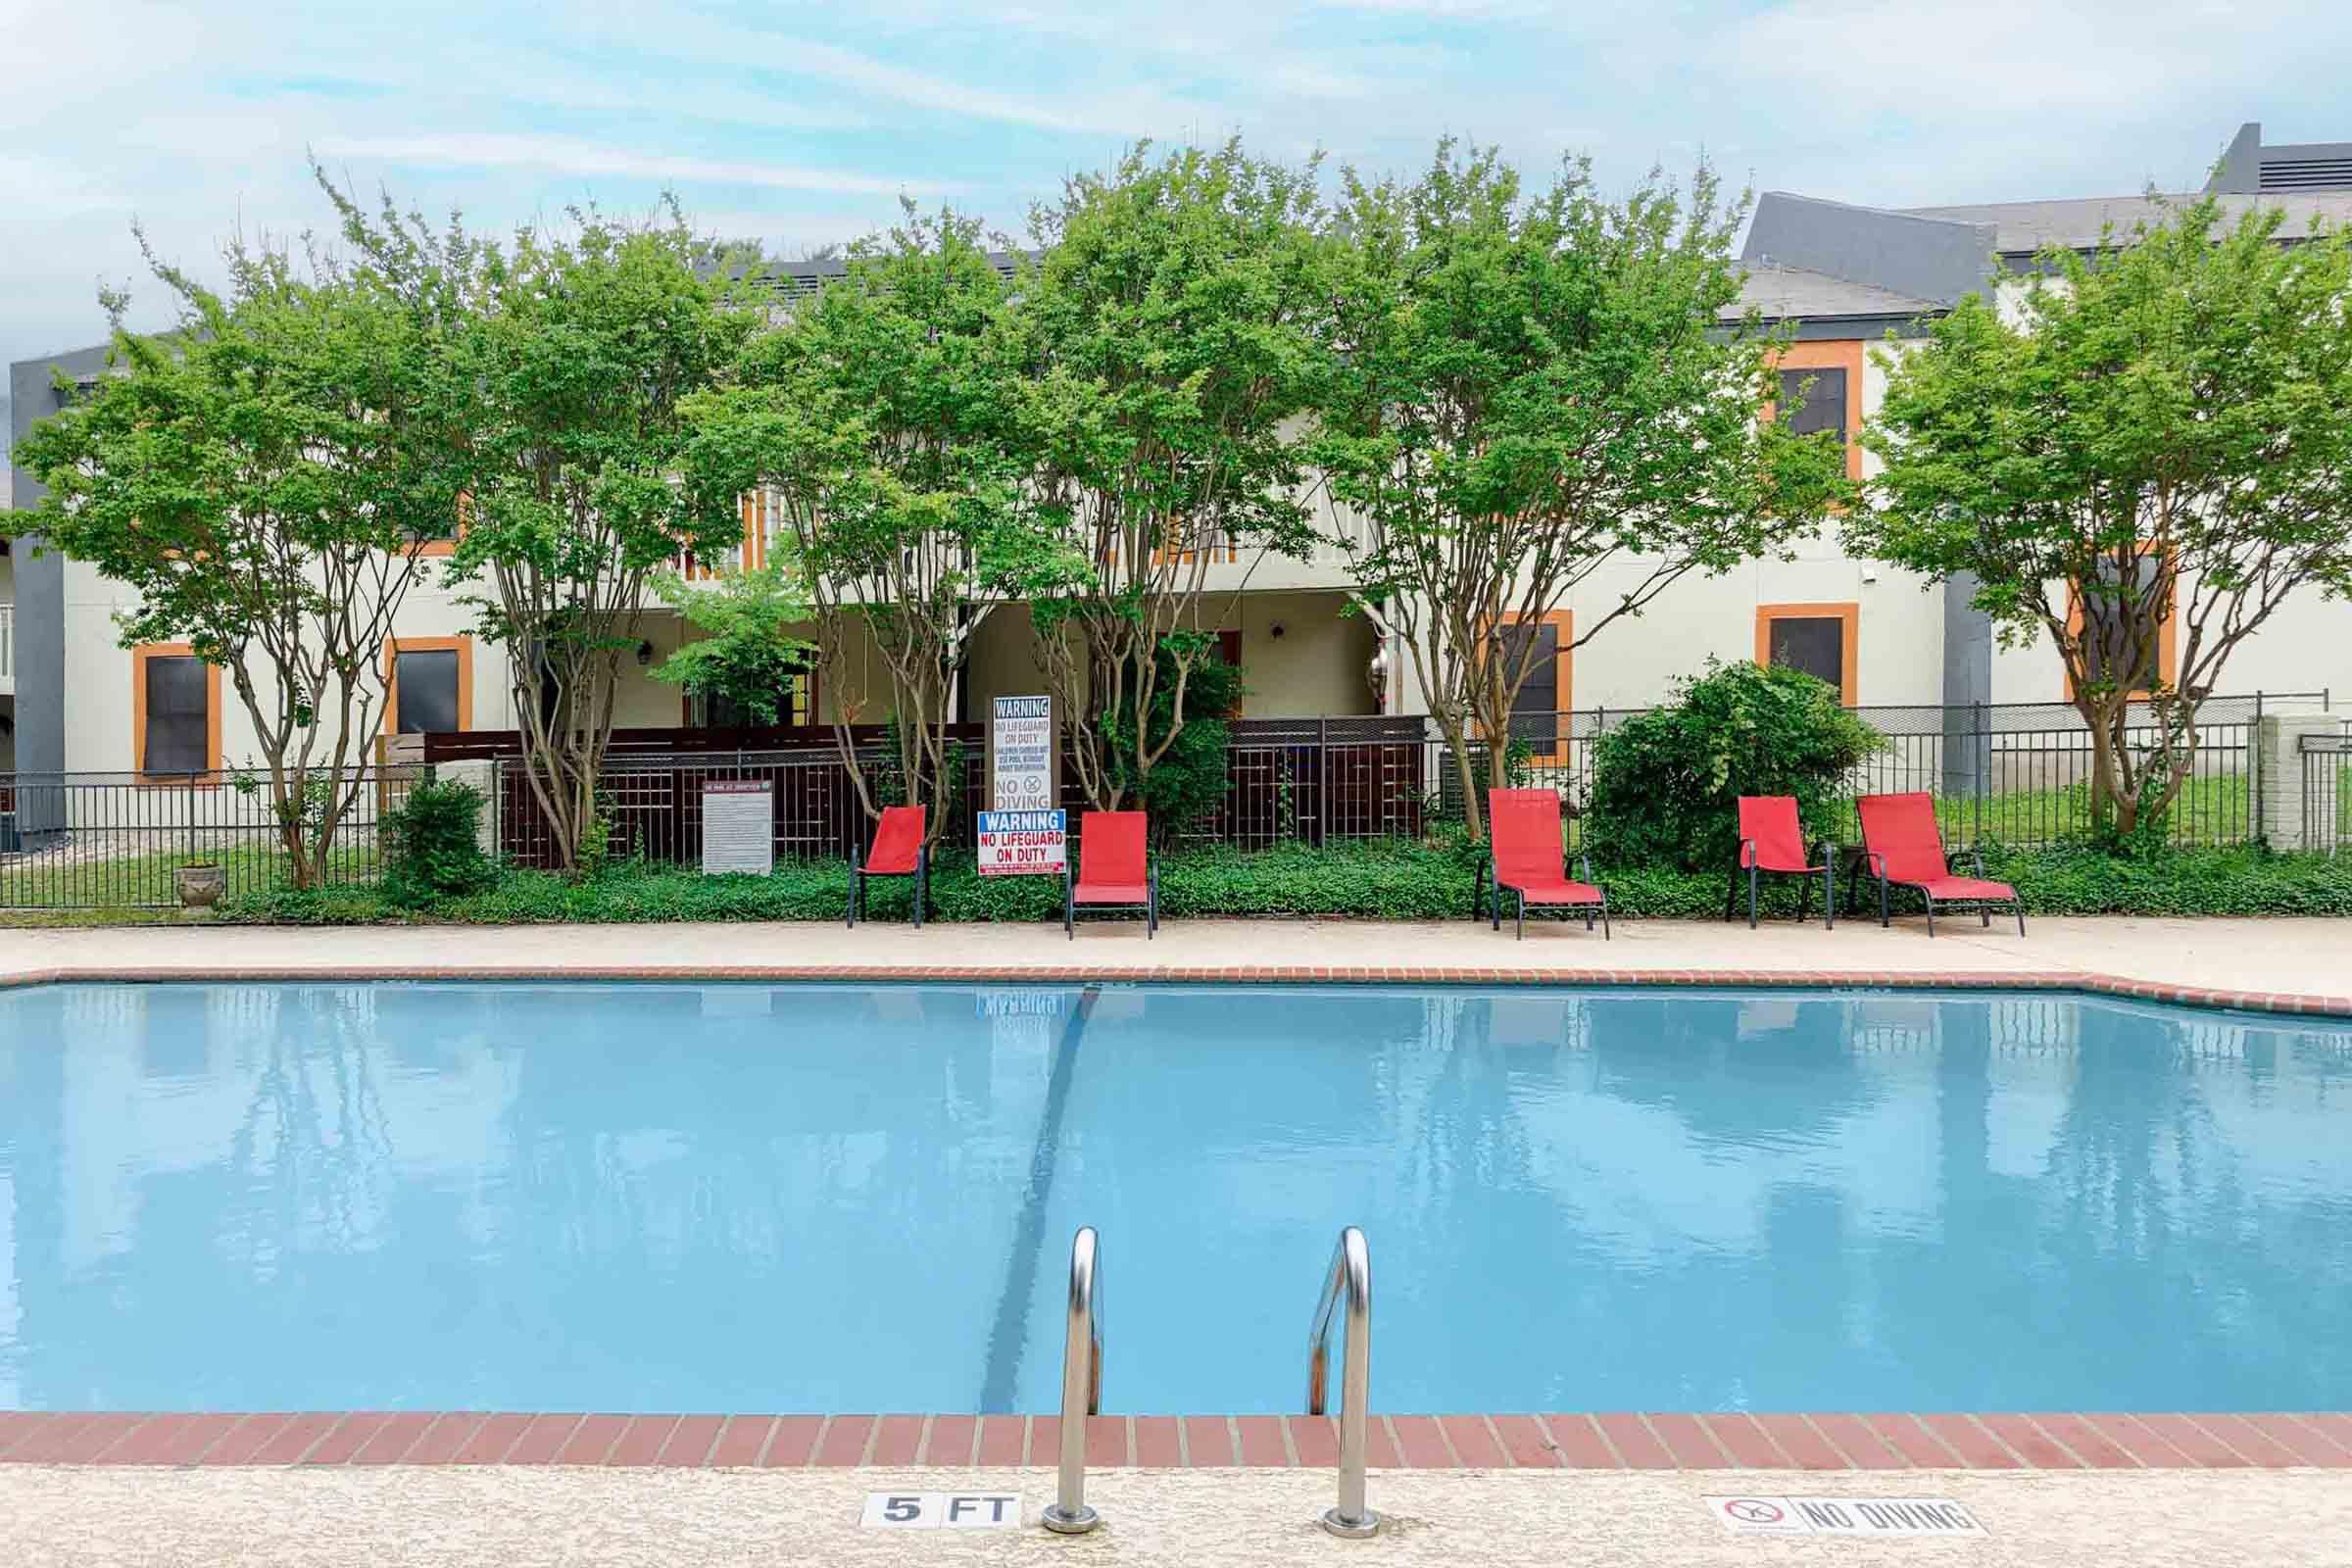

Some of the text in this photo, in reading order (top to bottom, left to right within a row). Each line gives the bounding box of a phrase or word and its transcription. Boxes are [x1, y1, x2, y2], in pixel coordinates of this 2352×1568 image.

[996, 699, 1048, 717] WARNING
[996, 720, 1049, 732] NO LIFEGUARD
[1005, 733, 1038, 745] ON DUTY
[996, 779, 1018, 794] NO
[996, 794, 1049, 808] DIVING
[986, 812, 1059, 832] WARNING
[981, 831, 1063, 847] NO LIFEGUARD
[997, 848, 1047, 862] ON DUTY
[883, 1496, 1016, 1522] 5 FT
[1799, 1502, 1975, 1529] NO DIVING
